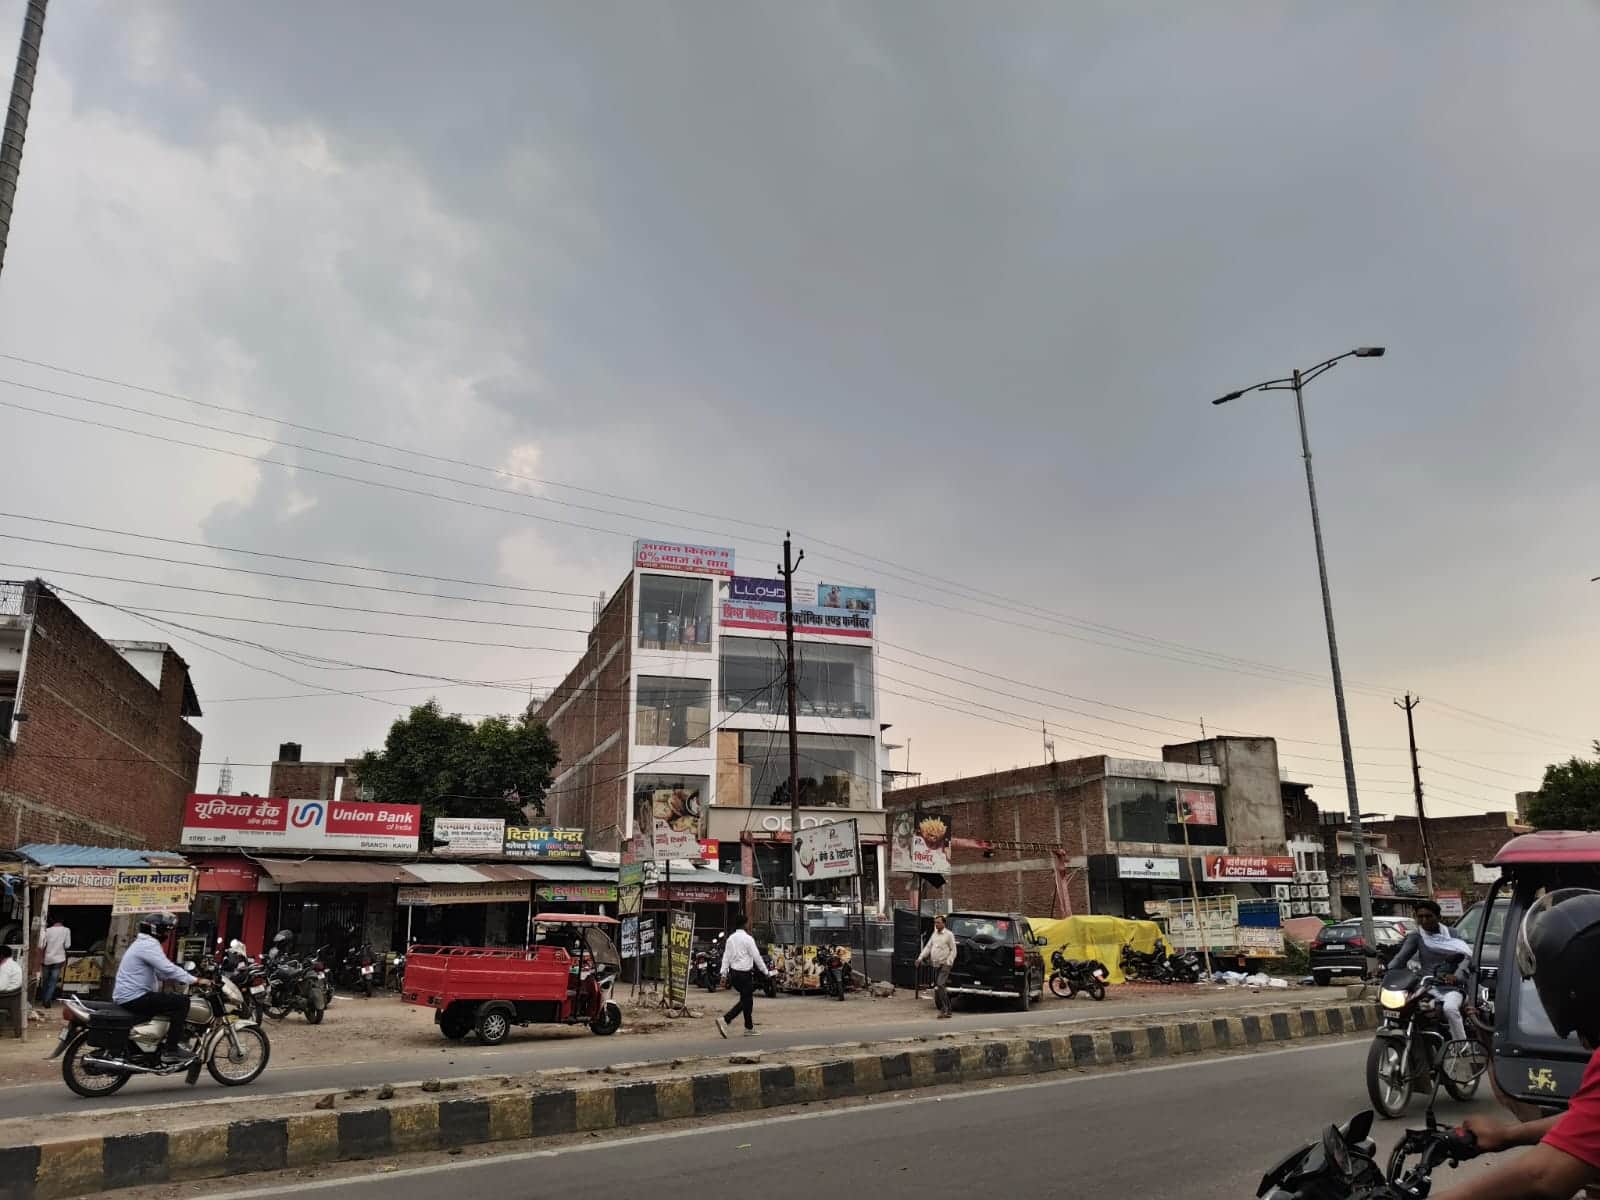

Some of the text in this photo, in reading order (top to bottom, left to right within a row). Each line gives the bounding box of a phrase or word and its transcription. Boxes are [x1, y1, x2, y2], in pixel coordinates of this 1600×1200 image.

[640, 551, 660, 562] 0%
[734, 583, 785, 598] LLOYD
[194, 799, 282, 820] यूनियन बैंक
[332, 808, 414, 824] Union Bank
[394, 824, 413, 832] India
[506, 827, 549, 842] दिलीप
[551, 829, 584, 843] पेन्टर
[360, 841, 388, 849] BRANCH
[1225, 866, 1246, 876] ICICI
[1246, 867, 1268, 876] Bank
